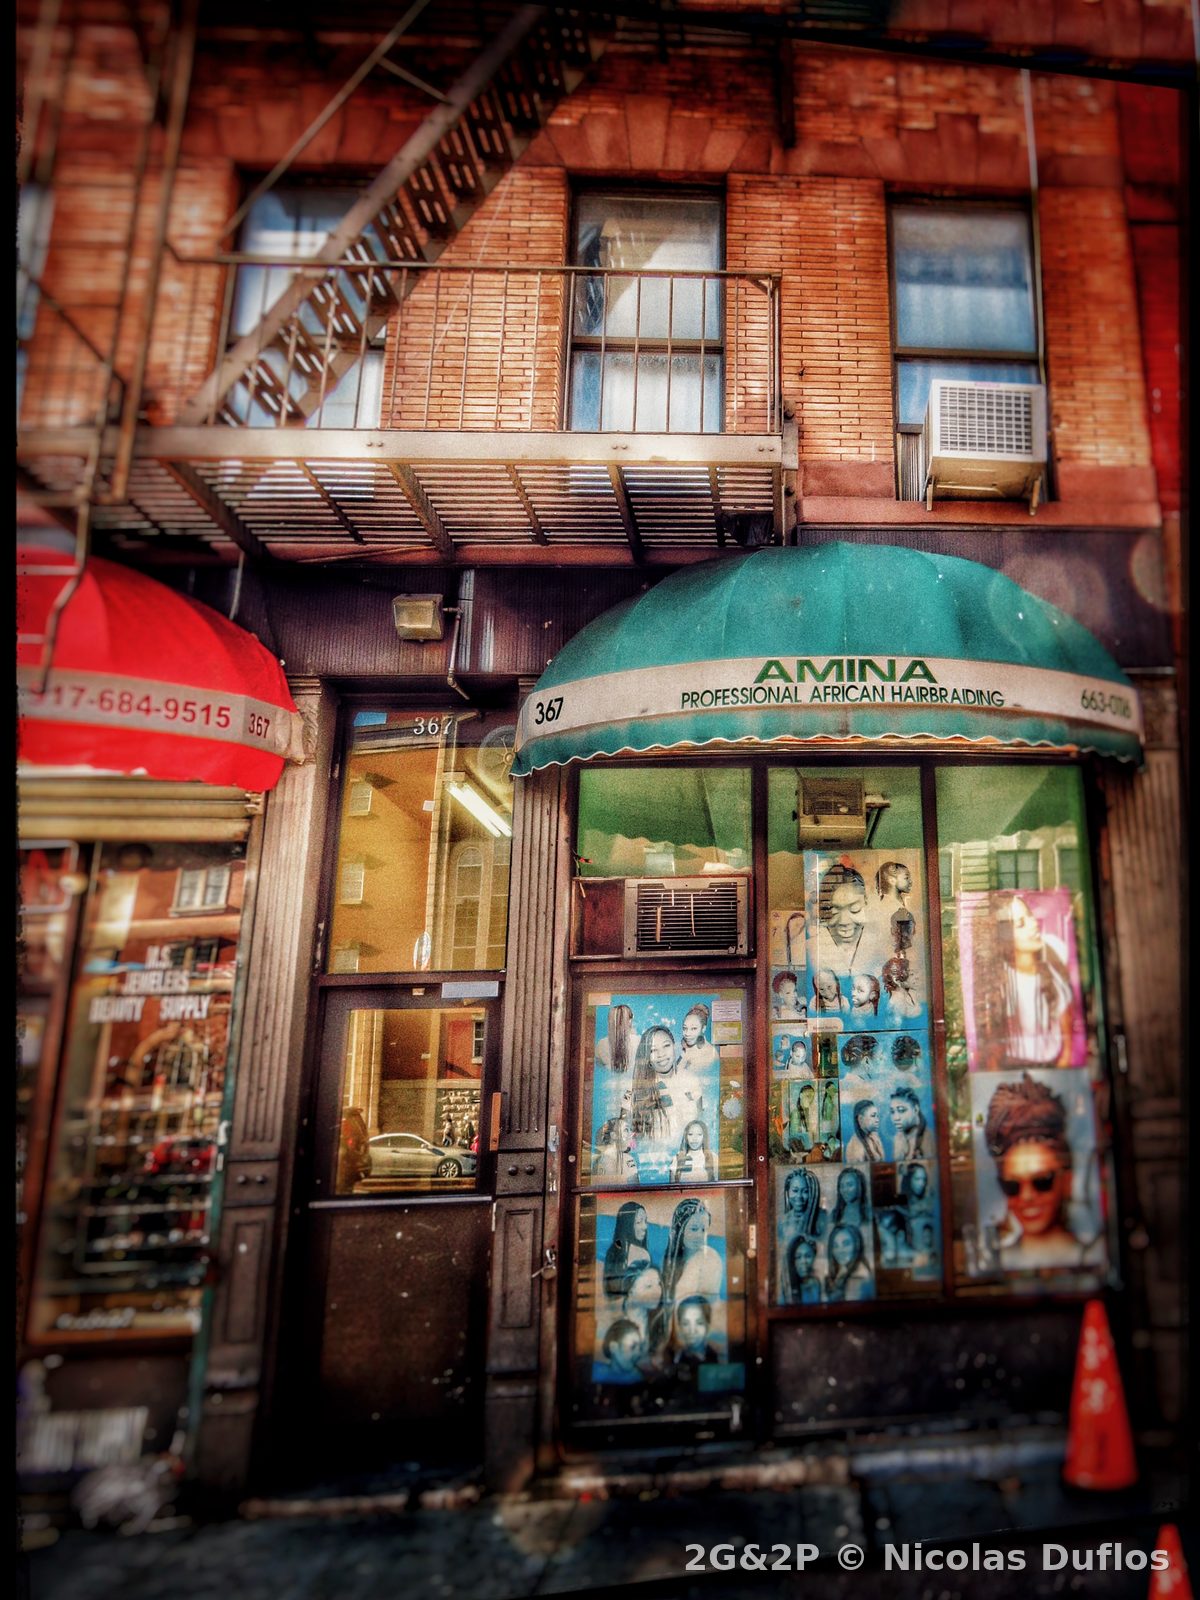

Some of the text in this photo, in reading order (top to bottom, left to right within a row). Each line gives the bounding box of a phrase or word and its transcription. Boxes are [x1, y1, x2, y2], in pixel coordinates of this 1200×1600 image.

[753, 658, 938, 684] AMINA
[680, 684, 1005, 710] PROFESSIONAL AFRICAN HAIRBRAIDING
[535, 697, 564, 725] 367
[248, 713, 271, 739] 367
[413, 715, 453, 735] 367
[160, 994, 212, 1020] SUPPLY
